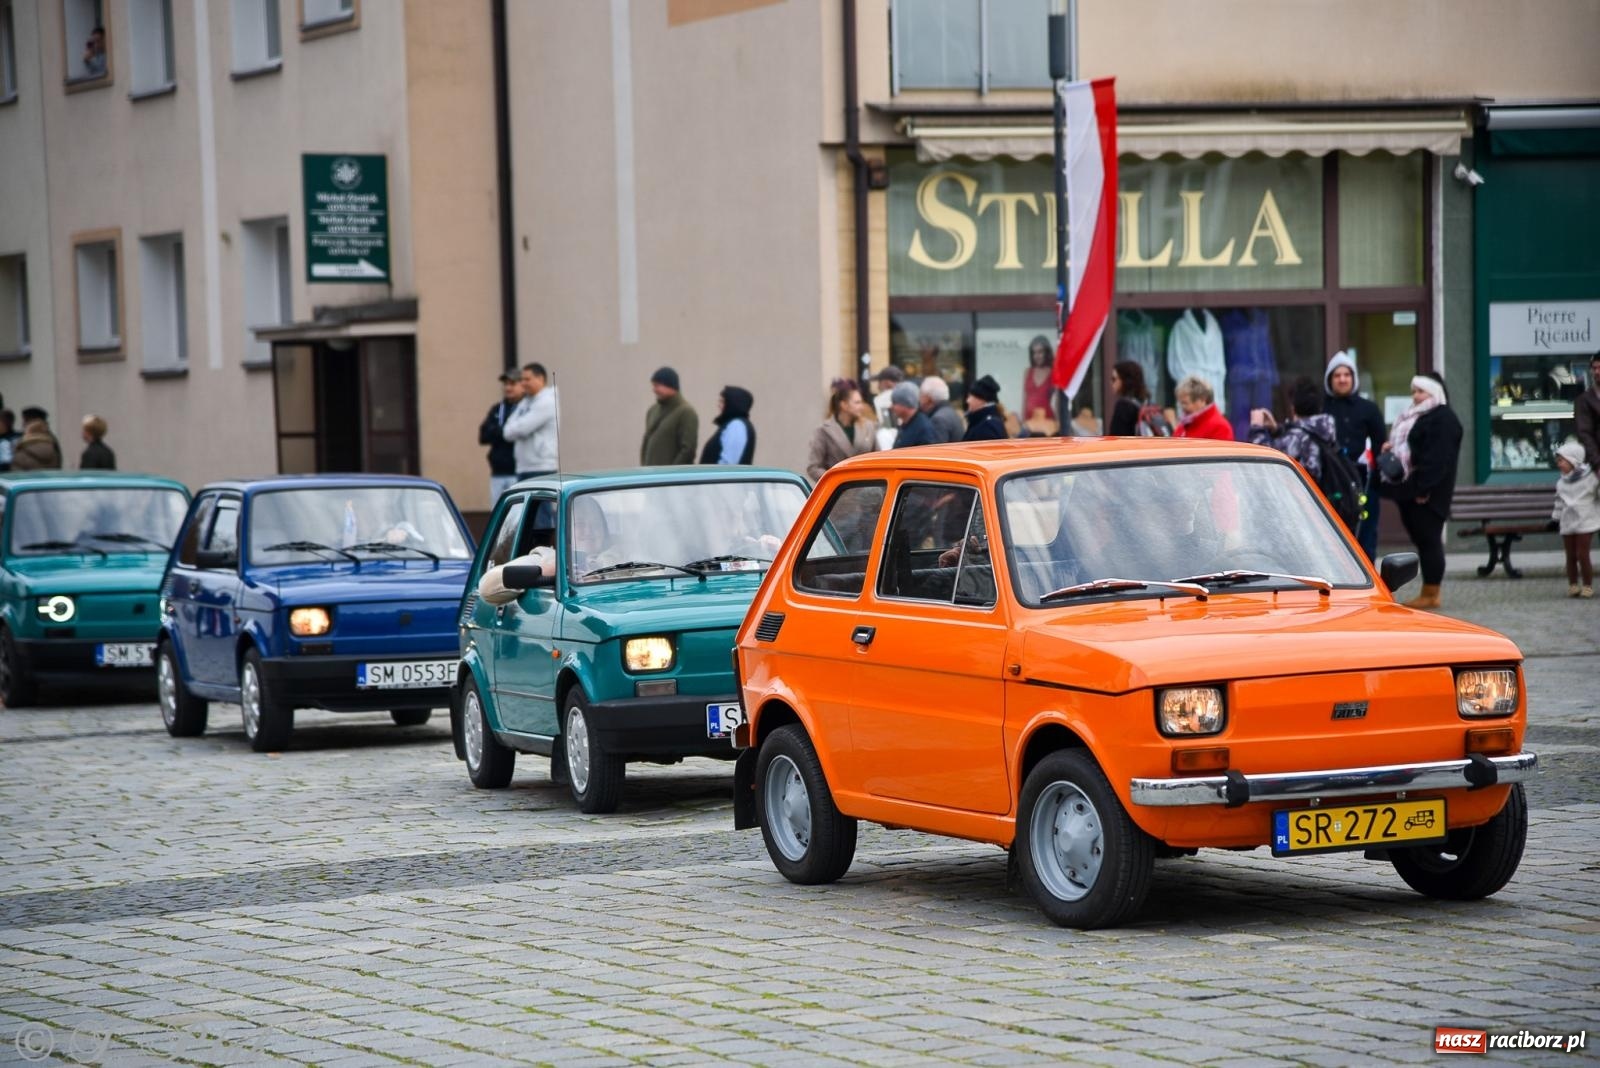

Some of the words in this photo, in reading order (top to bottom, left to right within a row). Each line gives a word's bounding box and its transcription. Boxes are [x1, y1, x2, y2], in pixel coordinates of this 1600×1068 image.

[1527, 305, 1576, 325] Pierre
[1534, 317, 1591, 349] Ricaud
[107, 646, 129, 662] SM
[370, 665, 395, 683] SM
[1335, 708, 1365, 718] FIAT
[1295, 813, 1332, 845] SR
[1344, 807, 1397, 841] 272
[1277, 836, 1288, 844] PL
